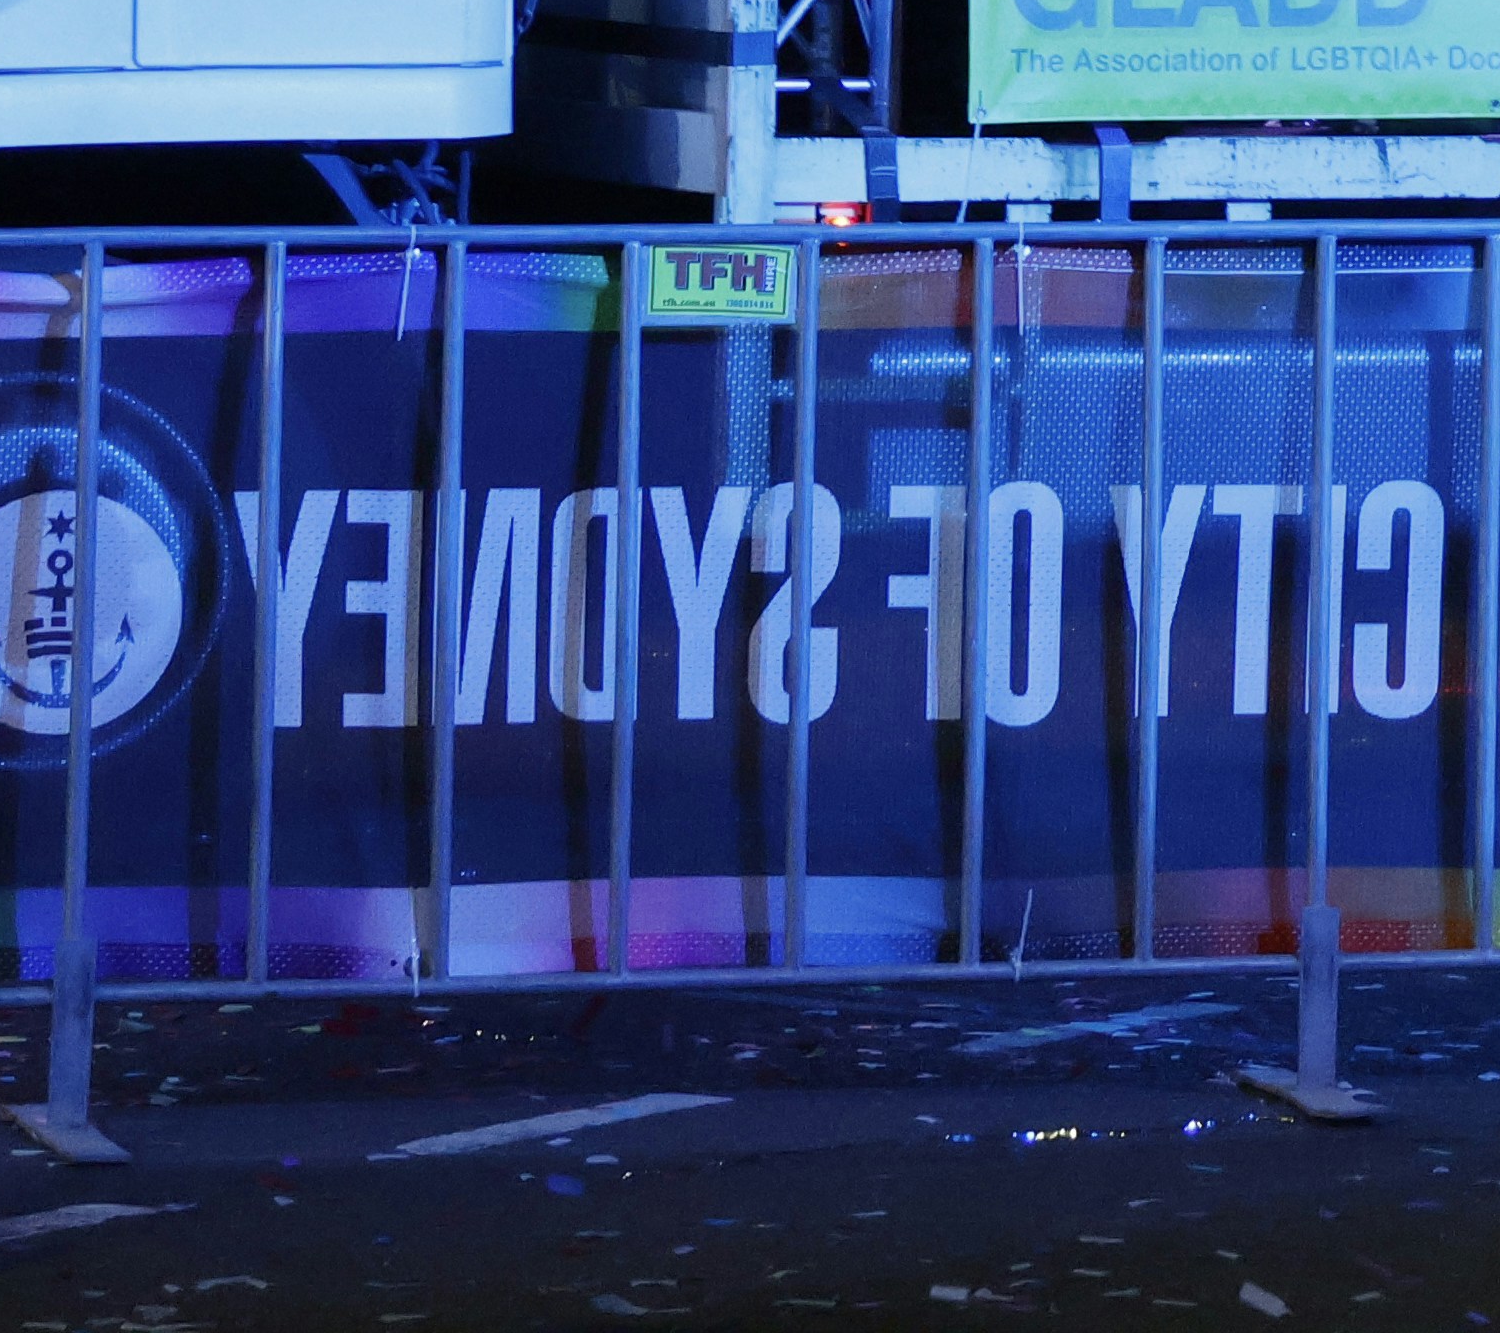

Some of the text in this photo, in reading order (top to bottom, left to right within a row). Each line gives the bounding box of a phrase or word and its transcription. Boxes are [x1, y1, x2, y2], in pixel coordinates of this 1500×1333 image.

[1011, 47, 1064, 73] The
[1073, 46, 1243, 73] Association
[1251, 46, 1279, 72] of
[1291, 45, 1440, 72] LGBTQIA+
[665, 250, 778, 293] TFH HIRE
